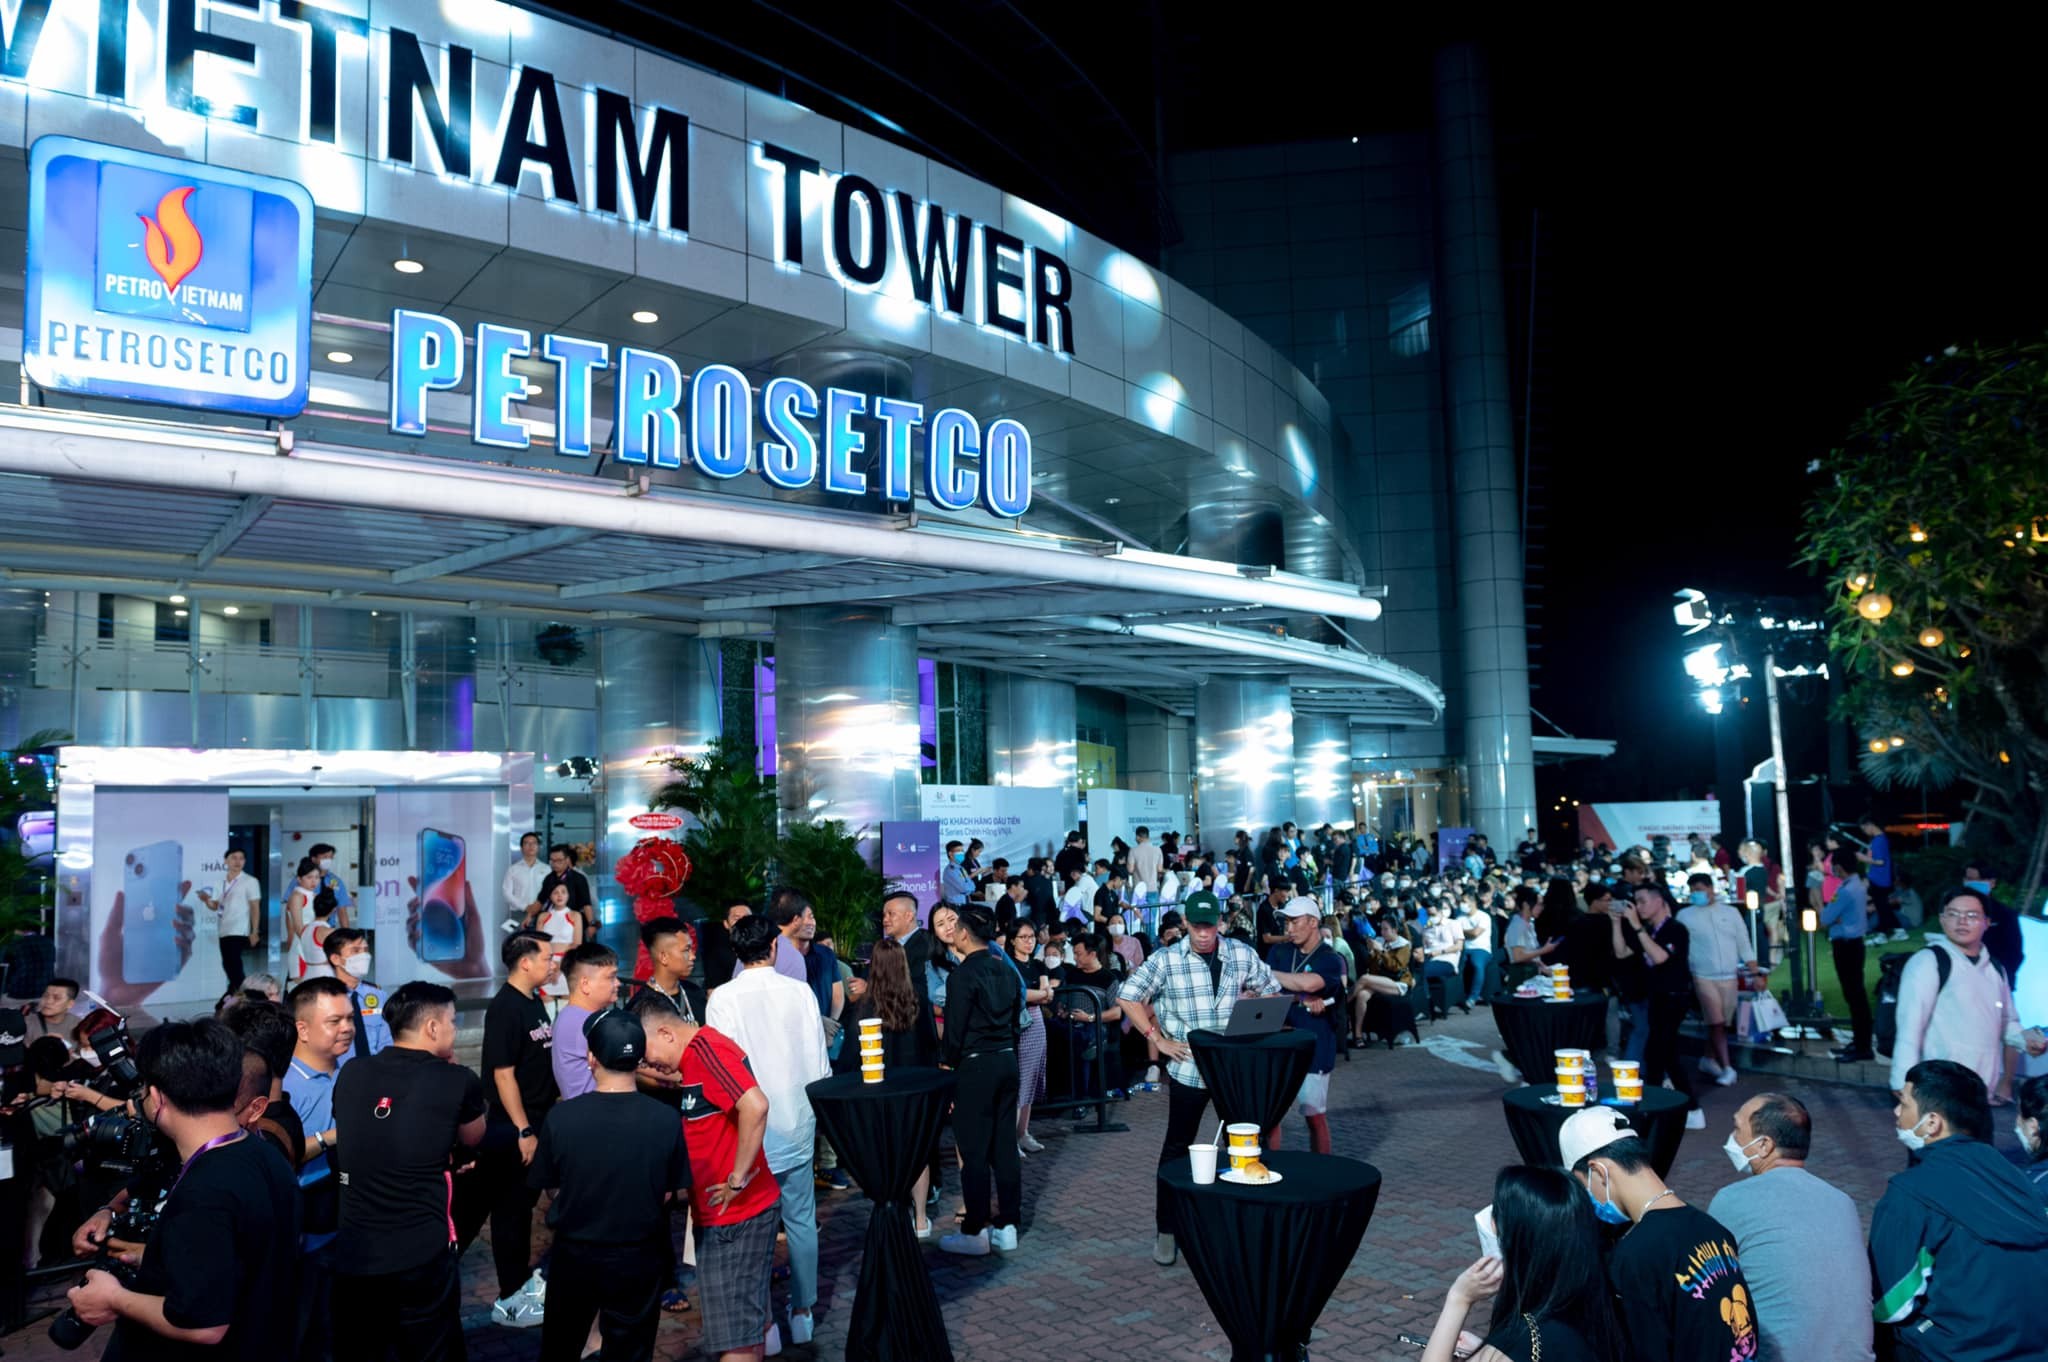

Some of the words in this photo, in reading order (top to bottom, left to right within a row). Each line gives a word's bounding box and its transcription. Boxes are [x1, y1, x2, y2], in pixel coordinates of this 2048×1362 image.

[105, 273, 243, 312] PETROVIETNAM
[757, 142, 1075, 357] TOWER
[48, 319, 289, 385] PETROSETCO
[389, 307, 1033, 519] PETROSETCO
